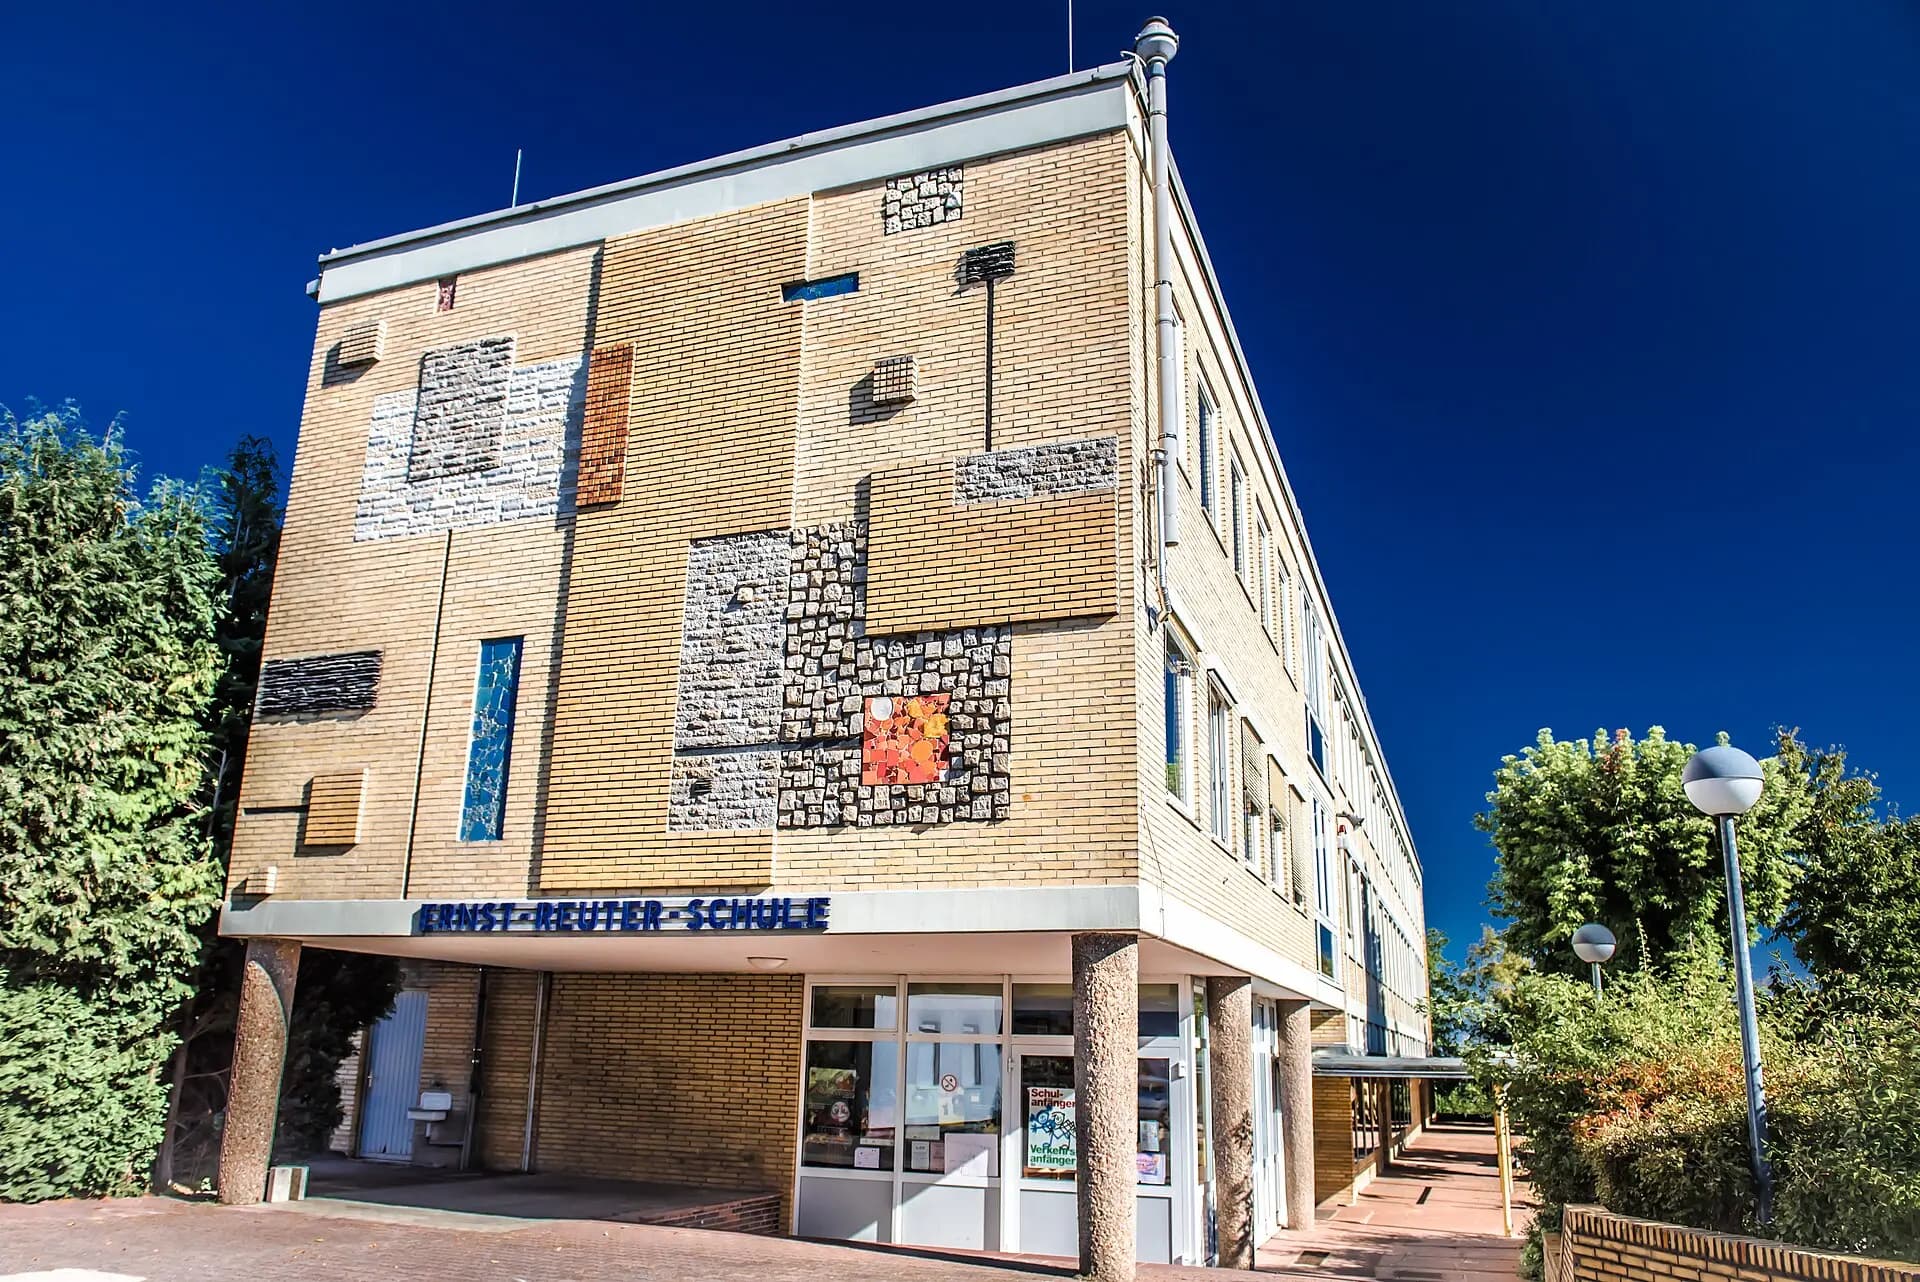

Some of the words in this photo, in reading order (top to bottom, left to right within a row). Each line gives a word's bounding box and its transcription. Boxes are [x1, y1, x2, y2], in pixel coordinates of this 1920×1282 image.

[420, 897, 830, 932] ERNST-REUTER-SCHULE
[1031, 1088, 1064, 1098] Schul-
[1031, 1098, 1076, 1109] anfänger
[1030, 1154, 1076, 1167] anfänger
